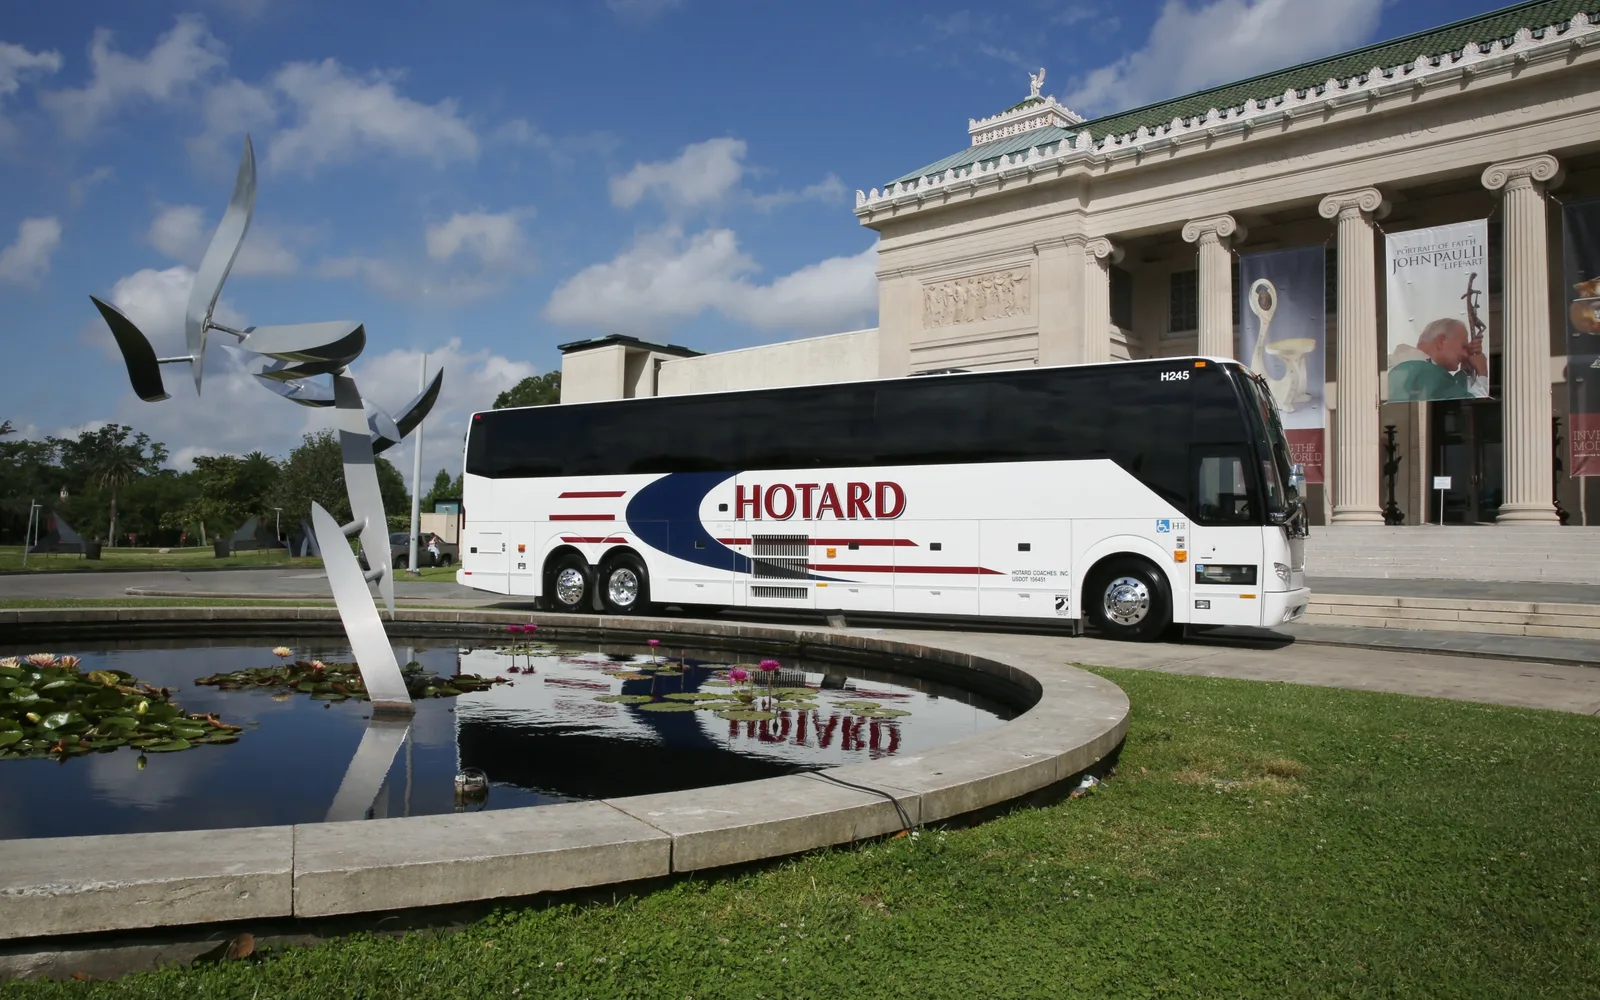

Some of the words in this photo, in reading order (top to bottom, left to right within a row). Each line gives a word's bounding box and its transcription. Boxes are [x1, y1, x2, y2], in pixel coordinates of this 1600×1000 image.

[1396, 244, 1436, 255] PORTRAIT
[1452, 239, 1476, 248] FAITH
[1160, 370, 1190, 382] H245
[1295, 443, 1316, 452] THE
[736, 482, 906, 521] HOTARD
